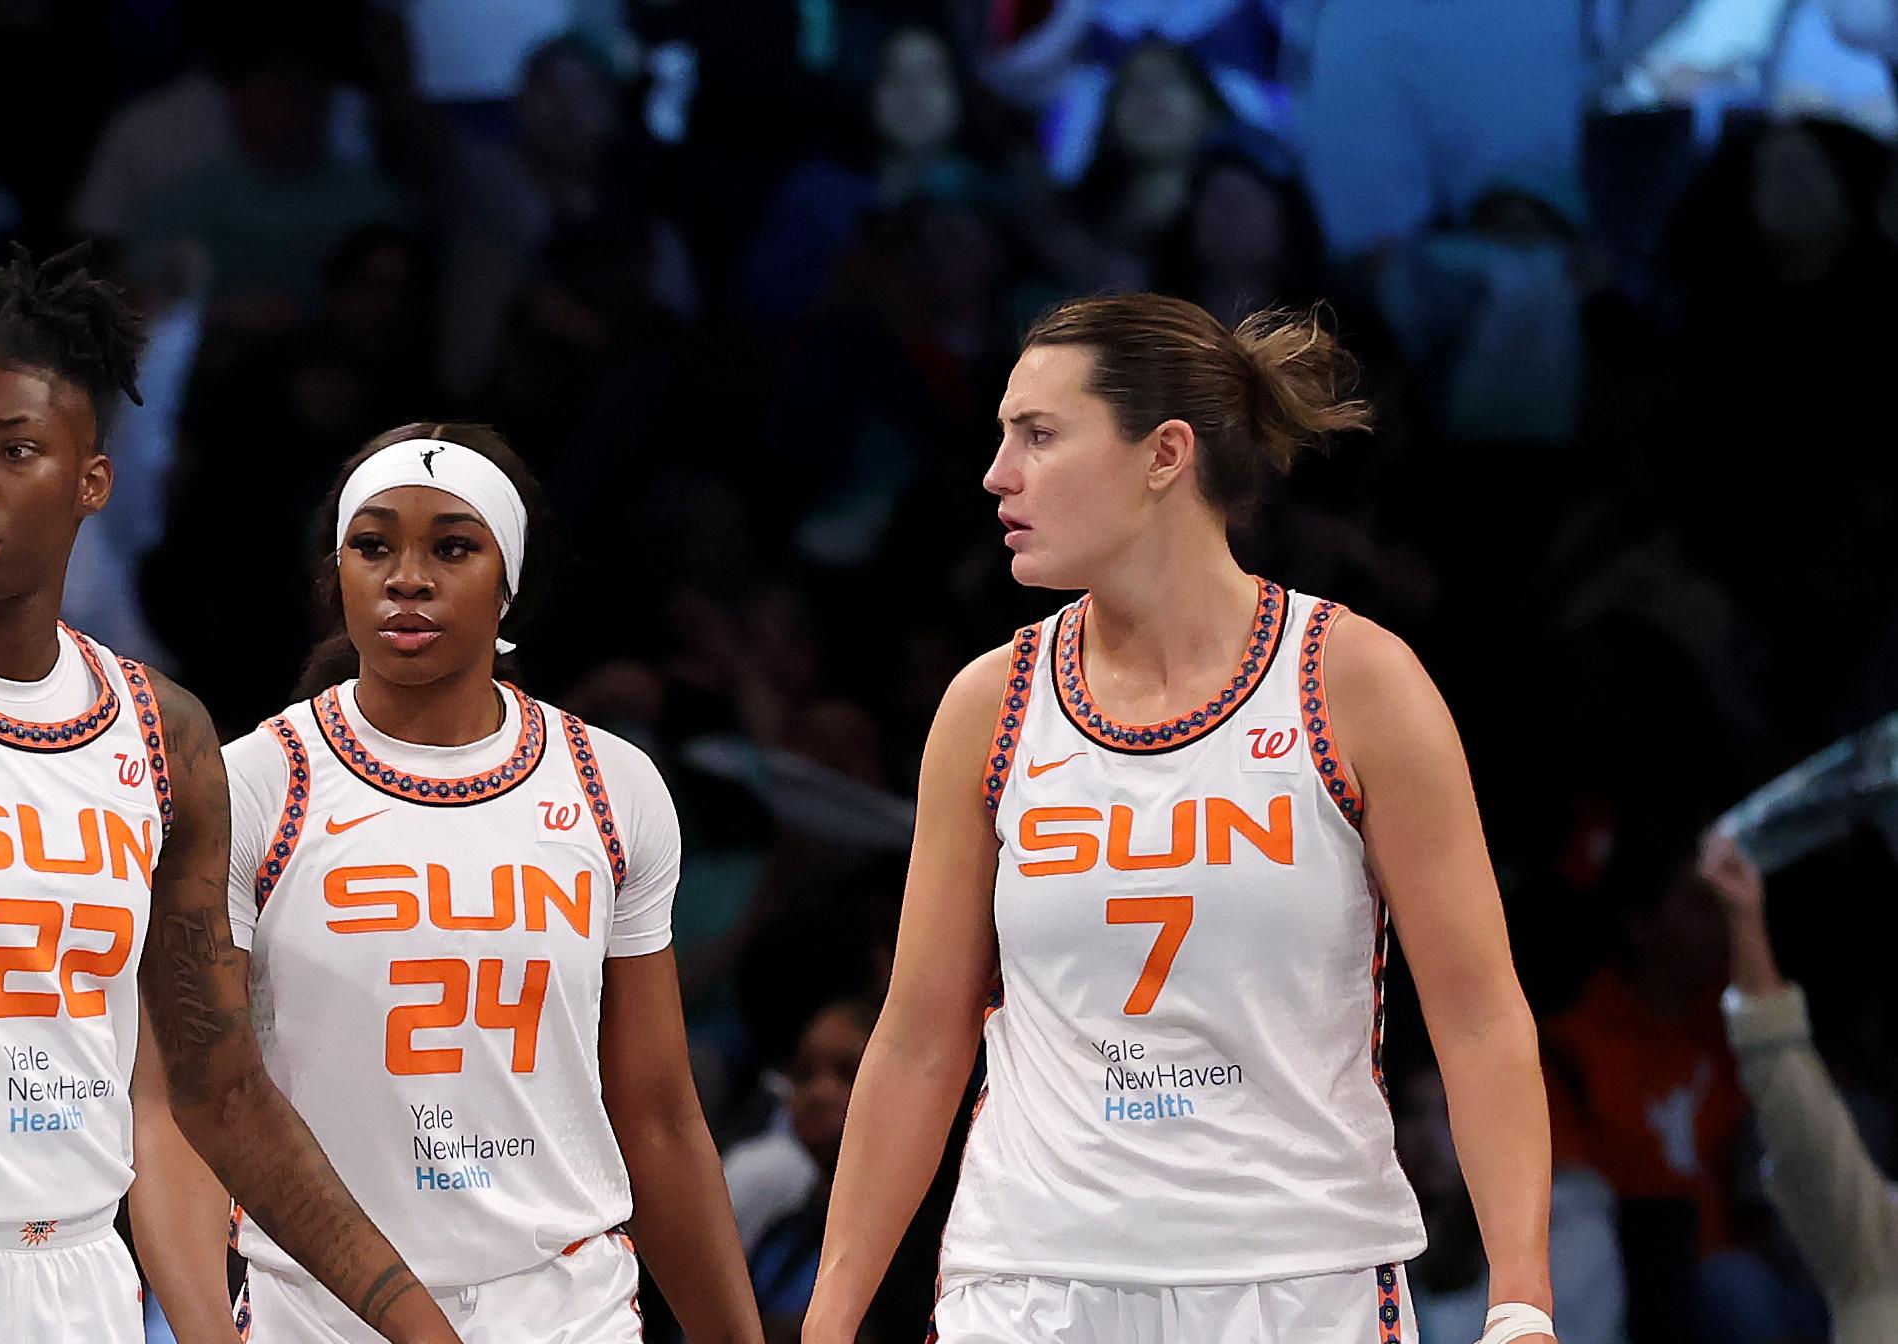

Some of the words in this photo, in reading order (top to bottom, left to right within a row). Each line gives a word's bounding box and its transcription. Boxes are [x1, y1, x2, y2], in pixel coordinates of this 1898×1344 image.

[1019, 796, 1293, 877] SUN
[324, 864, 591, 937] SUN
[1106, 896, 1193, 1015] 7
[386, 959, 550, 1075] 24
[4, 1046, 49, 1071] Yale
[1091, 1040, 1145, 1064] Yale
[9, 1076, 114, 1101] NewHaven
[1104, 1062, 1242, 1092] NewHaven
[11, 1108, 80, 1132] Health
[410, 1104, 453, 1130] Yale
[1106, 1095, 1192, 1120] Health
[414, 1134, 534, 1160] NewHaven
[417, 1168, 489, 1189] Health
